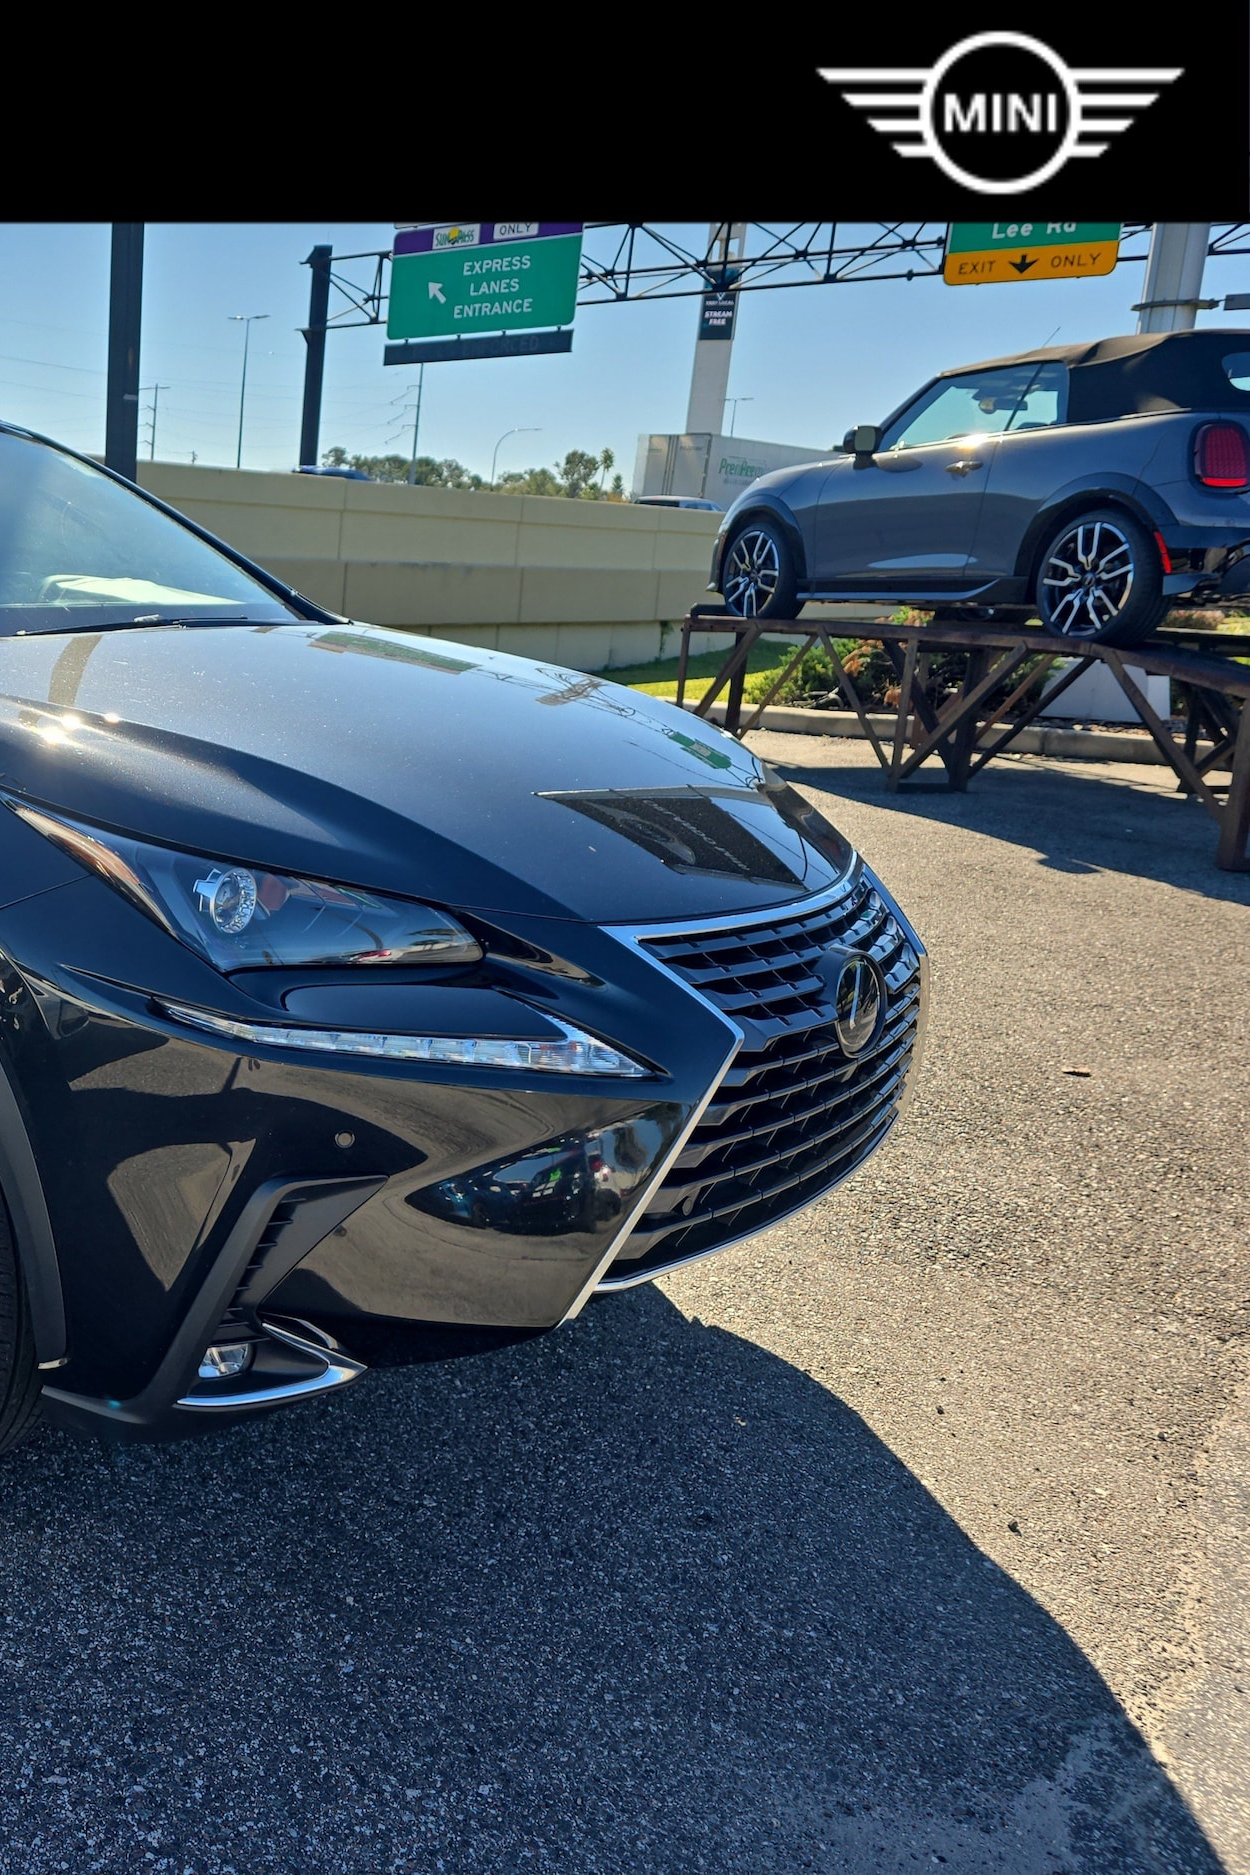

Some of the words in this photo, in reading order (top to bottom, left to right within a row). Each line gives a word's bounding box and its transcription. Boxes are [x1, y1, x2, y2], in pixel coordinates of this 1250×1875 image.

[499, 222, 534, 236] ONLY
[992, 222, 1034, 239] Lee
[463, 255, 531, 276] EXPRESS
[957, 260, 997, 275] EXIT
[1050, 252, 1102, 269] ONLY
[470, 278, 520, 296] LANES
[454, 298, 533, 318] ENTRANCE
[705, 310, 733, 318] STREAM
[709, 318, 727, 326] FREE
